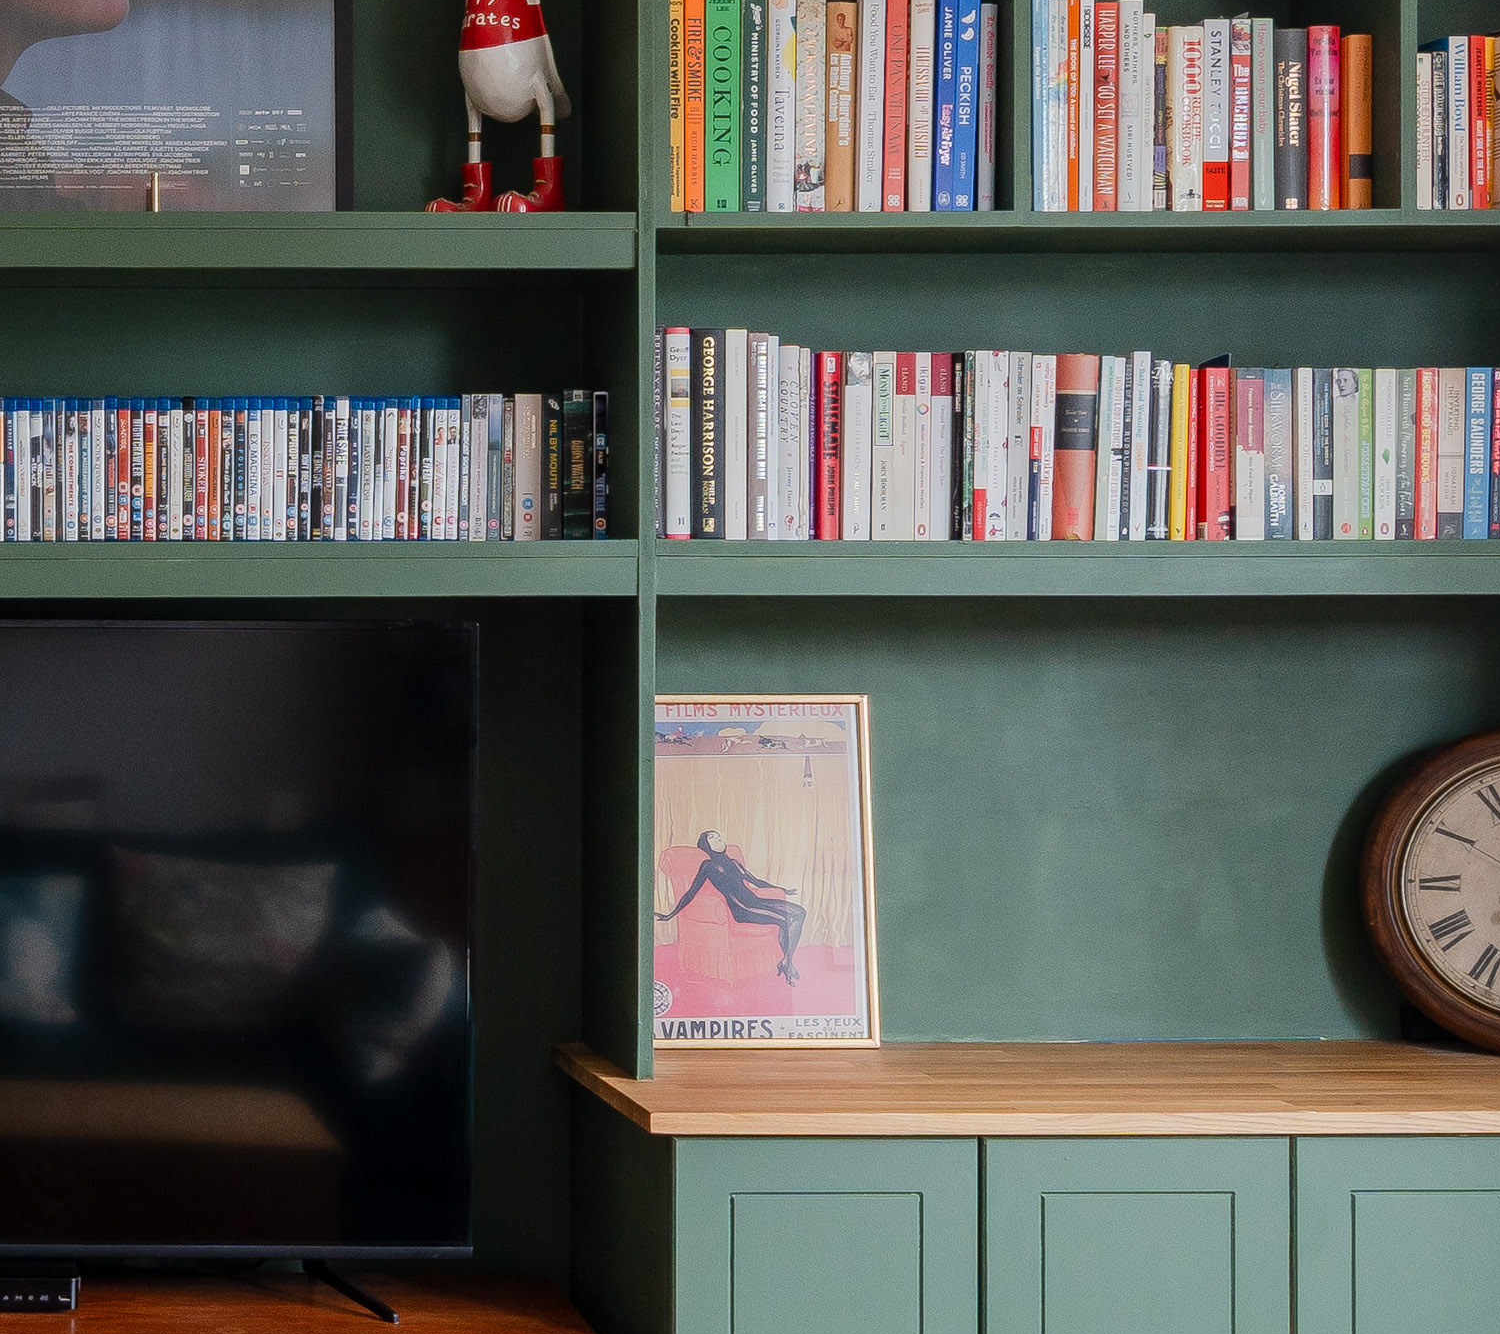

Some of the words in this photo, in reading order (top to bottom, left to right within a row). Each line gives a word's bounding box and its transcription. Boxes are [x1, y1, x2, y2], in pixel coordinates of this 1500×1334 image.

[687, 18, 702, 44] FIRE
[945, 7, 953, 39] JAMIE
[1098, 9, 1116, 51] HARPER
[670, 18, 680, 67] Cooking
[750, 33, 759, 82] MINISTRY
[943, 42, 952, 80] OLIVER
[1098, 53, 1116, 71] LEE
[1210, 30, 1222, 96] STANLEY
[1454, 43, 1465, 96] William
[670, 69, 680, 95] with
[687, 61, 702, 102] SMOKE
[712, 25, 732, 167] COOKING
[750, 86, 759, 99] OF
[959, 67, 972, 126] PECKISH
[670, 97, 680, 120] Fire
[750, 102, 759, 134] FOOD
[1453, 98, 1465, 132] Boyd
[750, 139, 758, 163] JAMIE
[750, 166, 758, 194] OLIVER
[703, 336, 715, 395] GEORGE
[1471, 372, 1485, 415] GEORGE
[250, 433, 258, 446] EX
[550, 419, 558, 433] NIL
[550, 435, 558, 446] BY
[702, 400, 715, 476] HARRISON
[1470, 418, 1485, 475] SAUNDERS
[250, 449, 258, 497] MACHINA
[549, 451, 558, 489] MOUTH
[666, 704, 718, 717] FILMS
[662, 1020, 773, 1038] VAMPIRES
[795, 1018, 819, 1027] LES
[824, 1018, 862, 1027] YEUX
